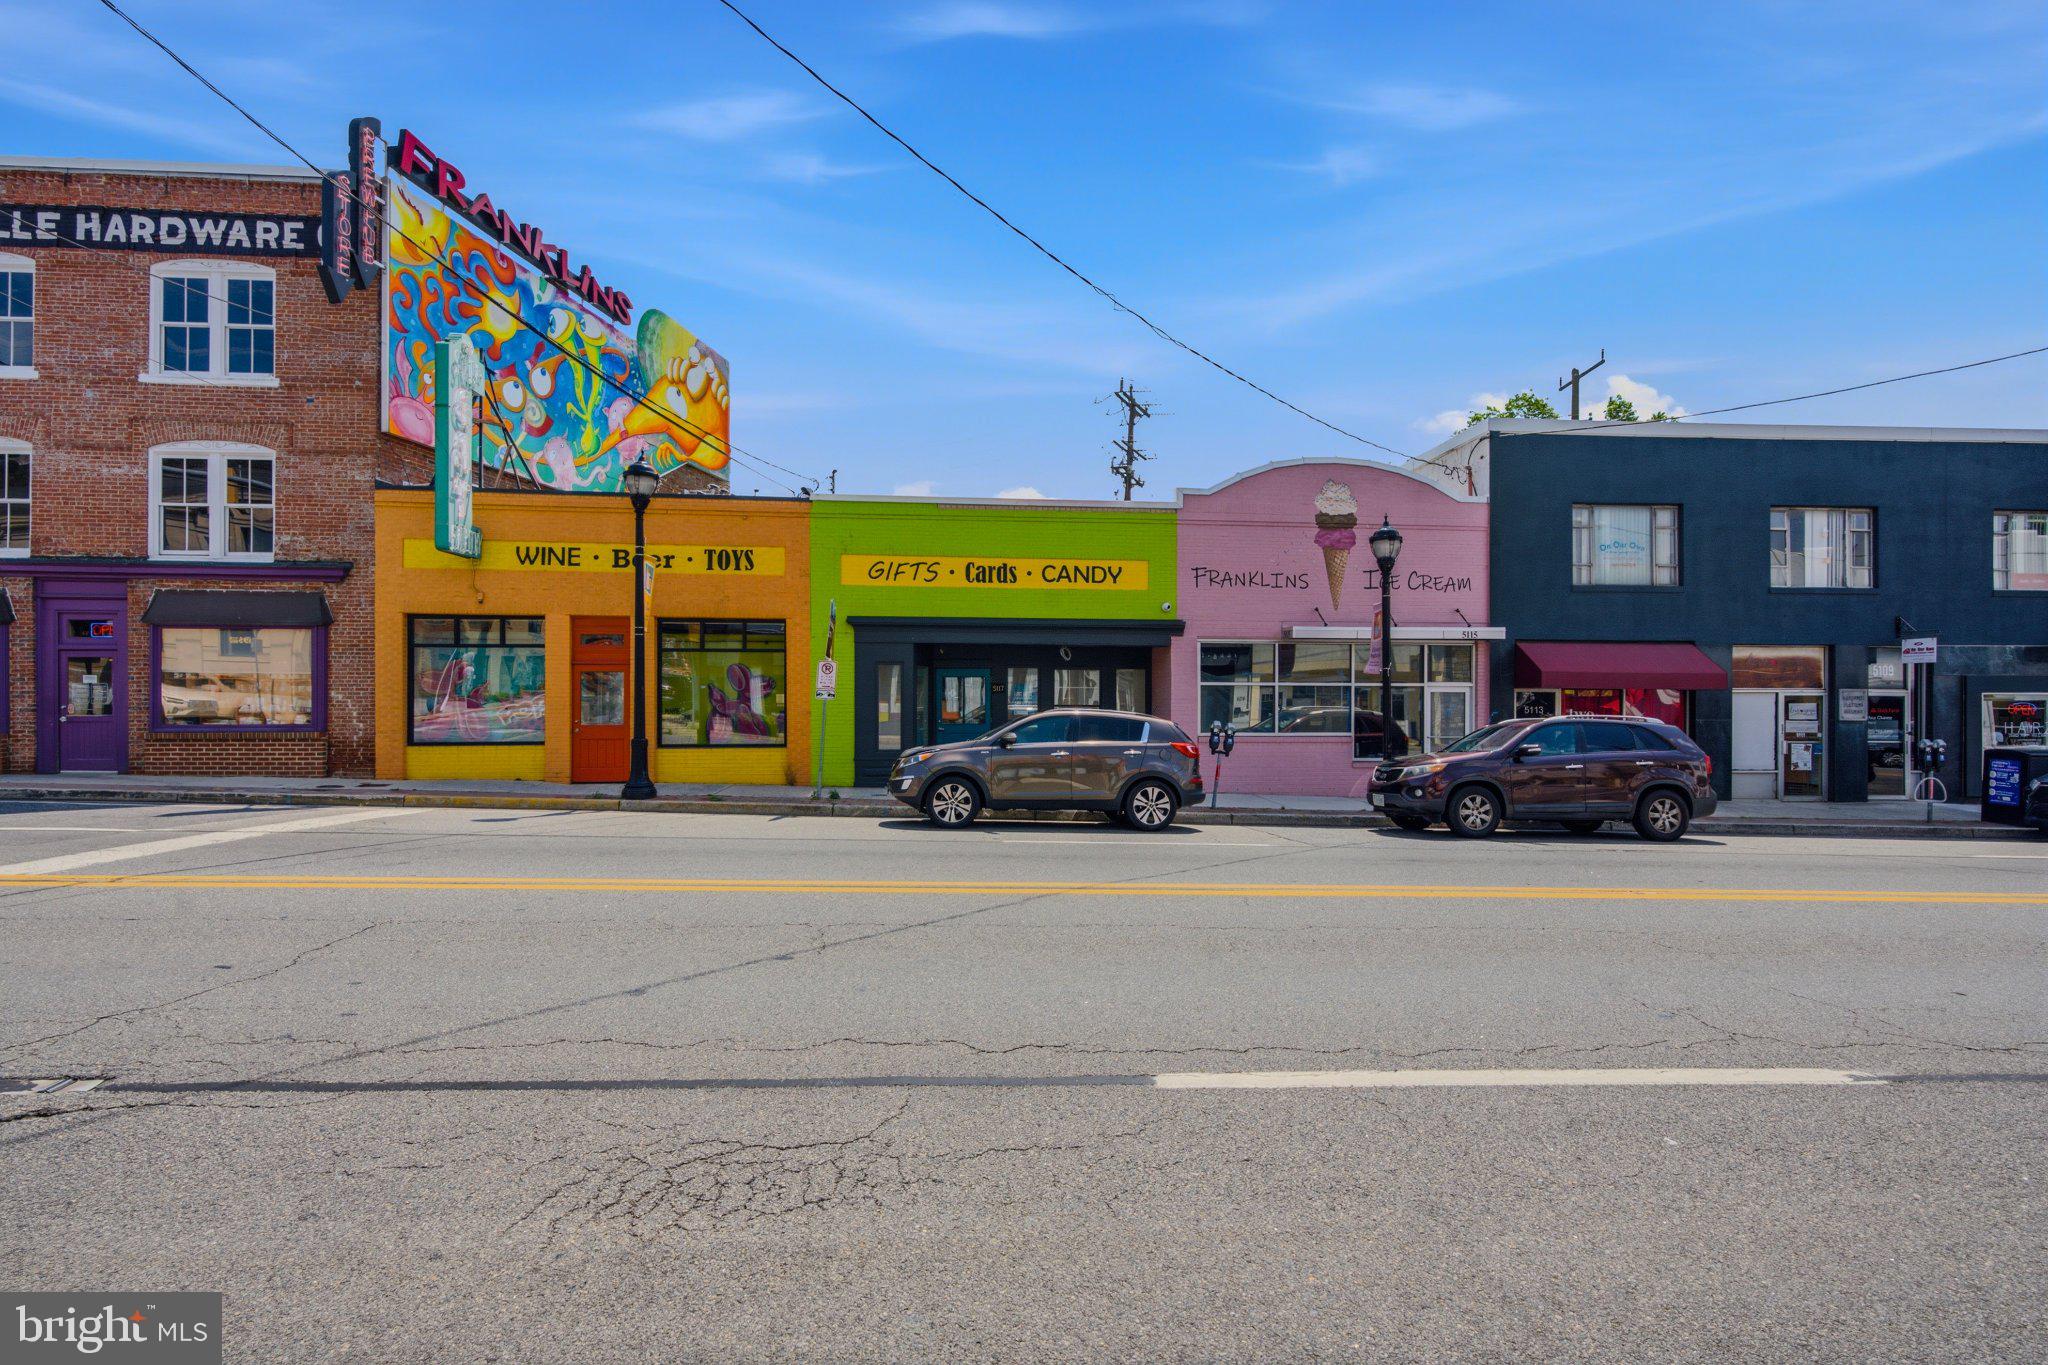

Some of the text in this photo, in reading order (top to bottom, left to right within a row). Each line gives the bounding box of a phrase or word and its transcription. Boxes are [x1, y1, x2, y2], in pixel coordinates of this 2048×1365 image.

[0, 210, 60, 239] LE
[76, 212, 304, 249] HARDWARE
[337, 175, 351, 278] STORE
[400, 129, 634, 325] FRANKLINS
[516, 546, 754, 571] WINE Br TOYS
[867, 561, 1122, 584] GIFTS Cards CANDY
[1191, 566, 1310, 590] FRANKLINS
[1407, 570, 1472, 592] CREAM
[1462, 631, 1478, 639] 5115
[1872, 664, 1894, 676] 5109
[1524, 705, 1544, 714] 5113
